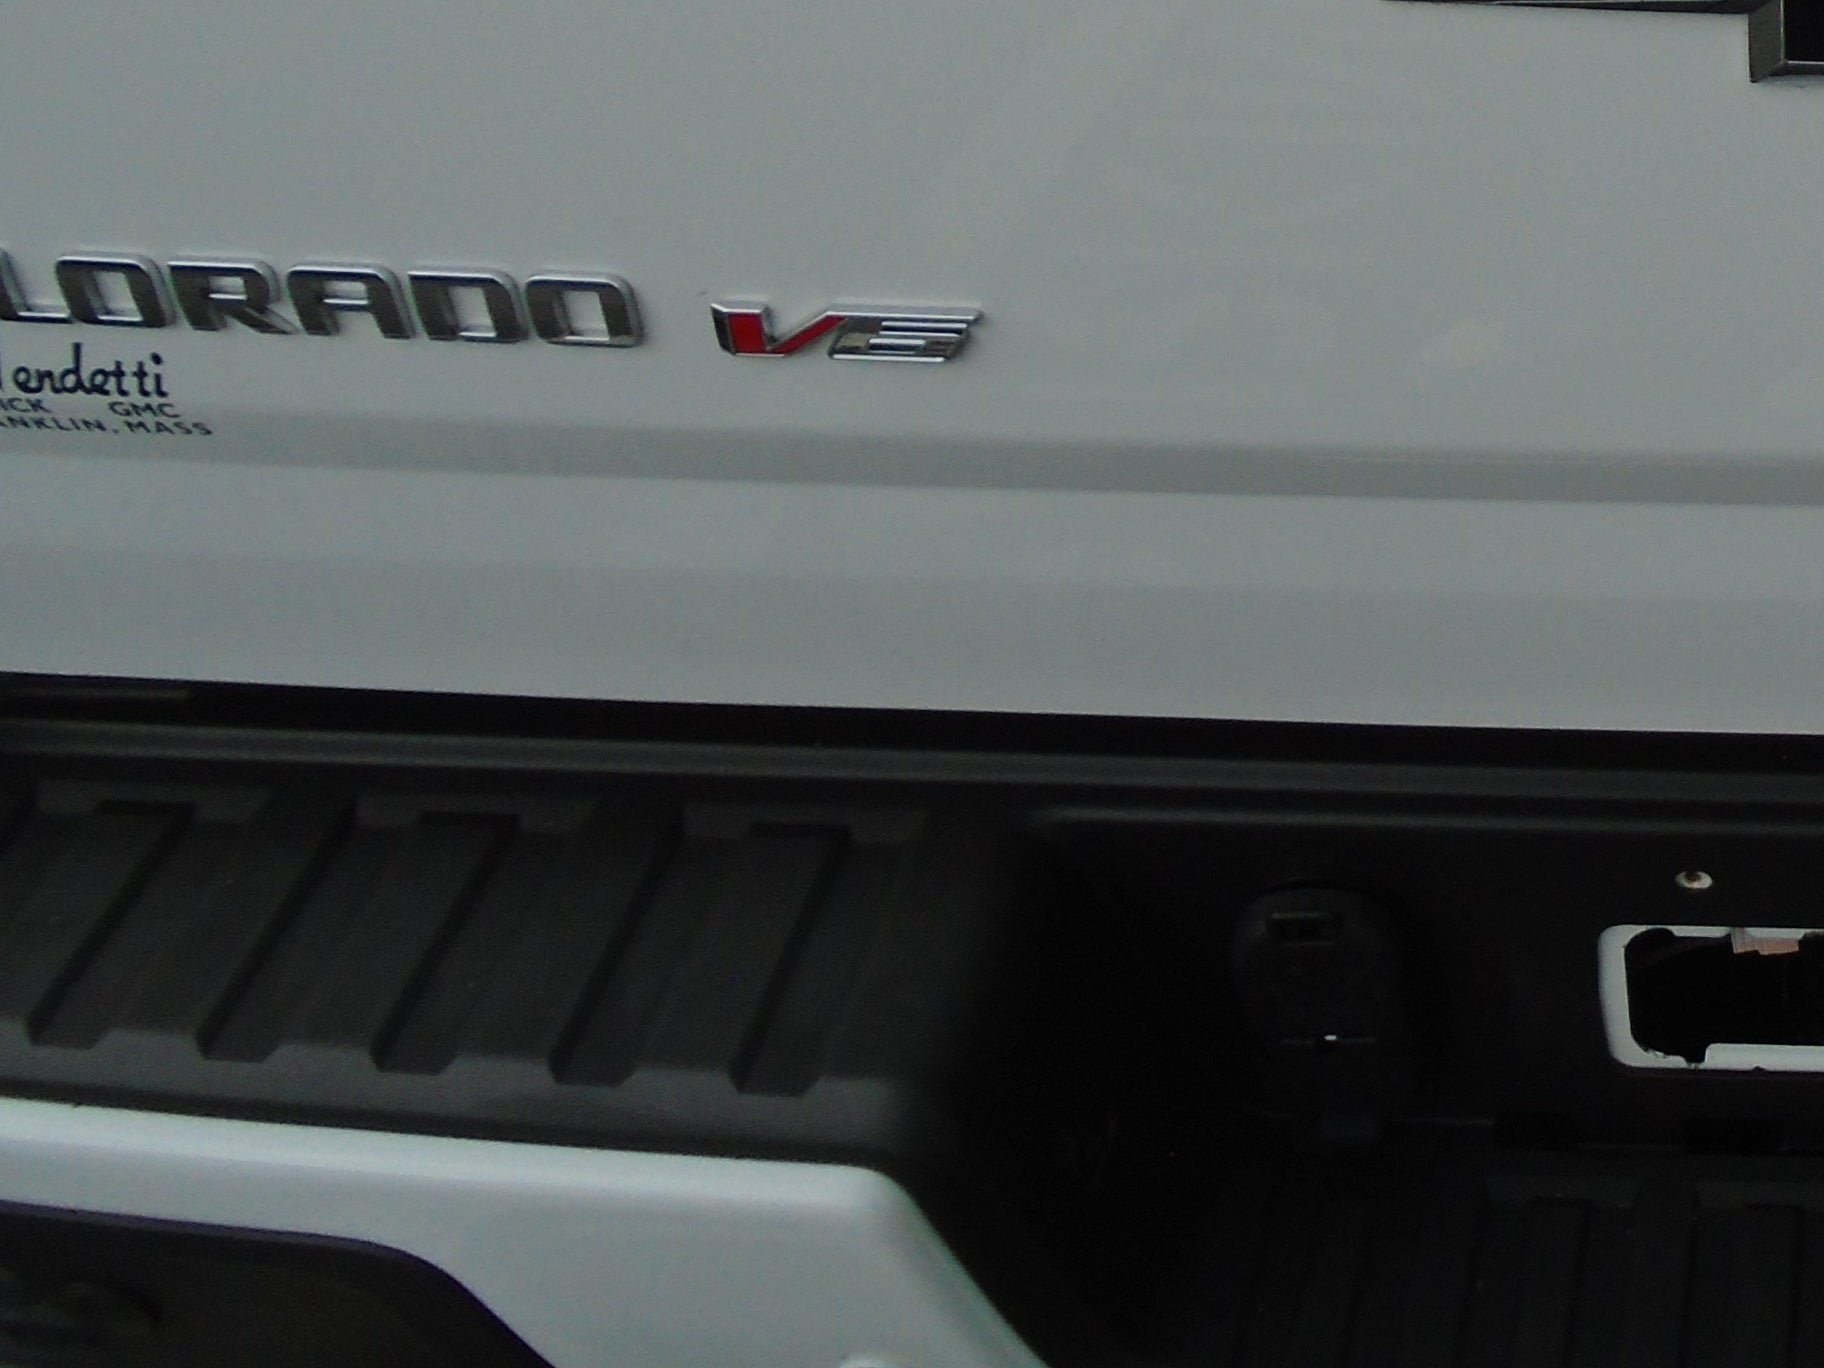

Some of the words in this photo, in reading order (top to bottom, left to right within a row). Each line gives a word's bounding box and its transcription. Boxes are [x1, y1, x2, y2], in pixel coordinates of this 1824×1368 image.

[710, 300, 984, 363] V6
[0, 342, 168, 397] endetti
[107, 401, 181, 419] GMC
[123, 421, 213, 436] MASS
